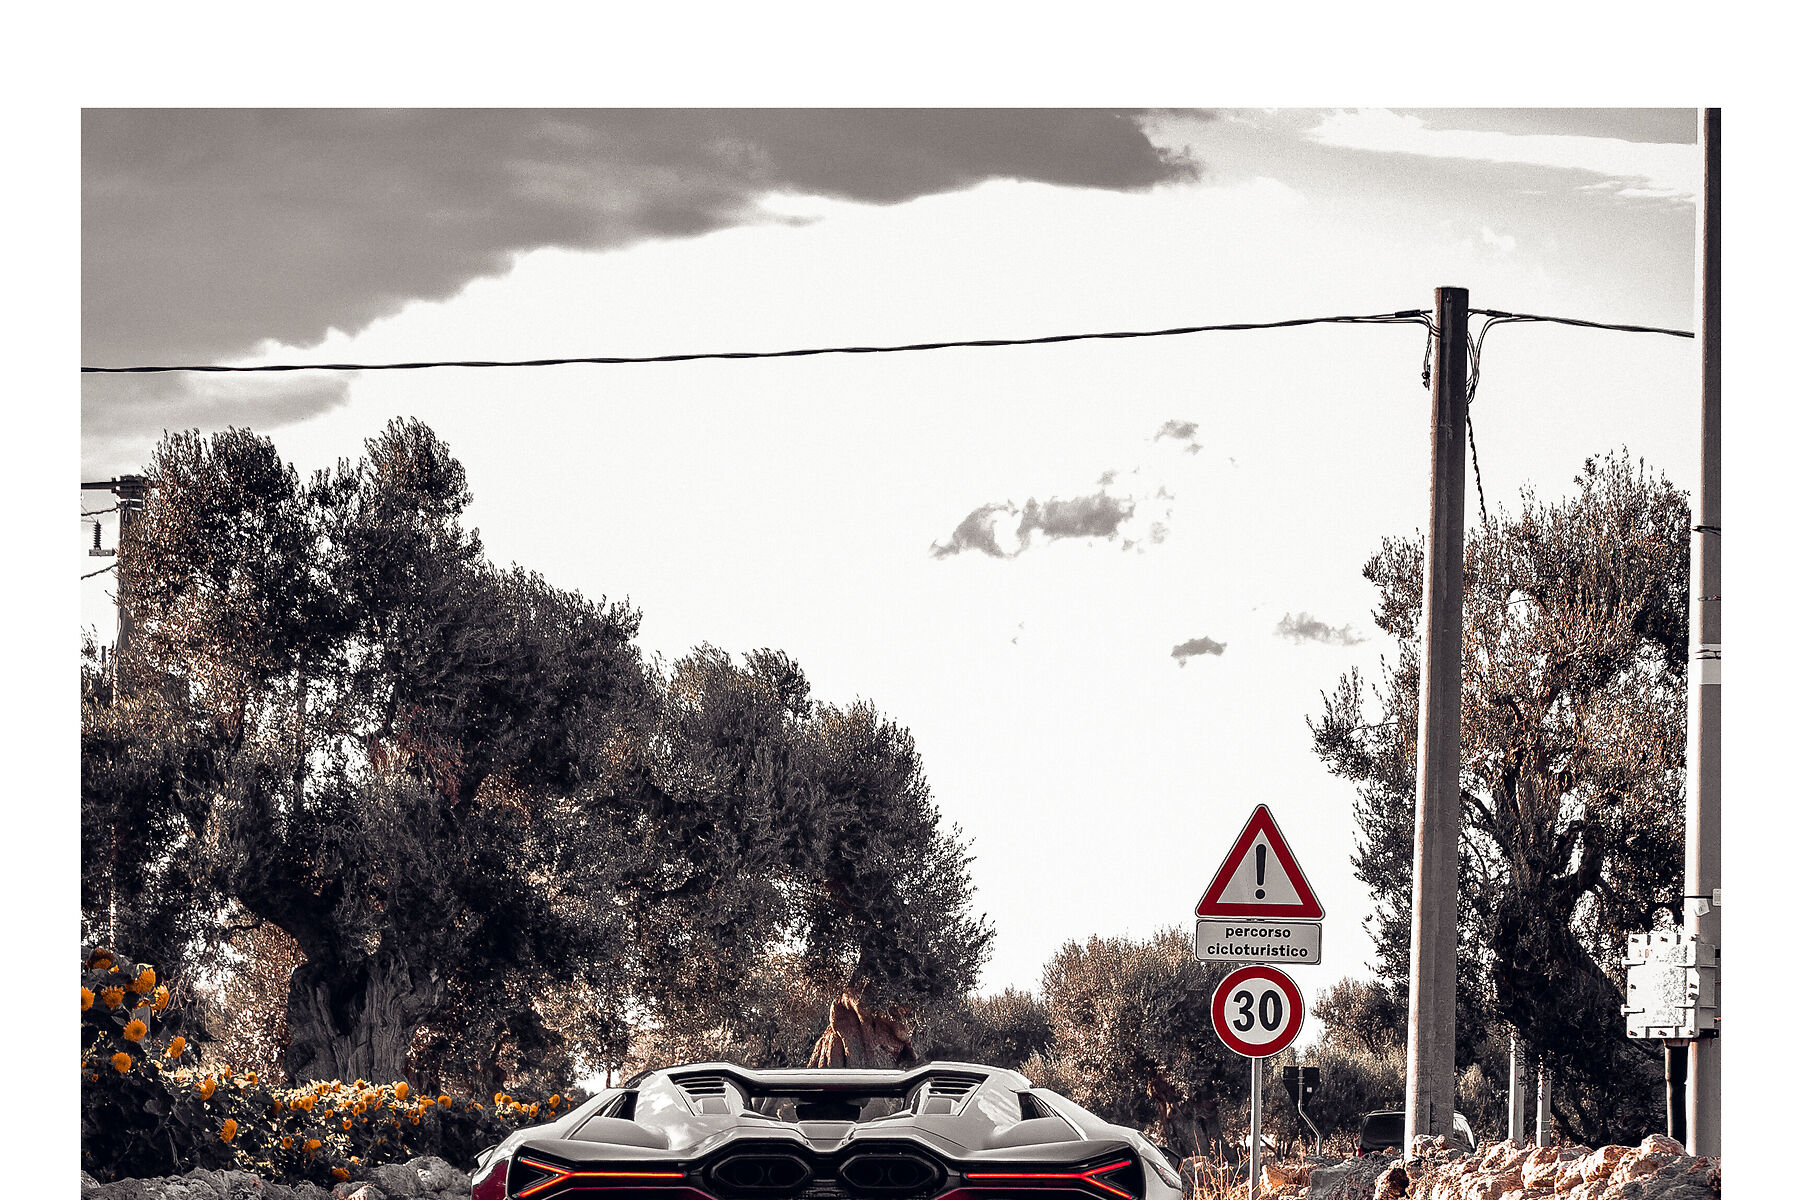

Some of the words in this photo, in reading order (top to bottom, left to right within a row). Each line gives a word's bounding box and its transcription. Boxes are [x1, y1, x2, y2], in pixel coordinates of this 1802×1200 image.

[1225, 926, 1291, 938] percorso
[1207, 943, 1308, 957] cicloturistico
[1233, 990, 1283, 1032] 30
